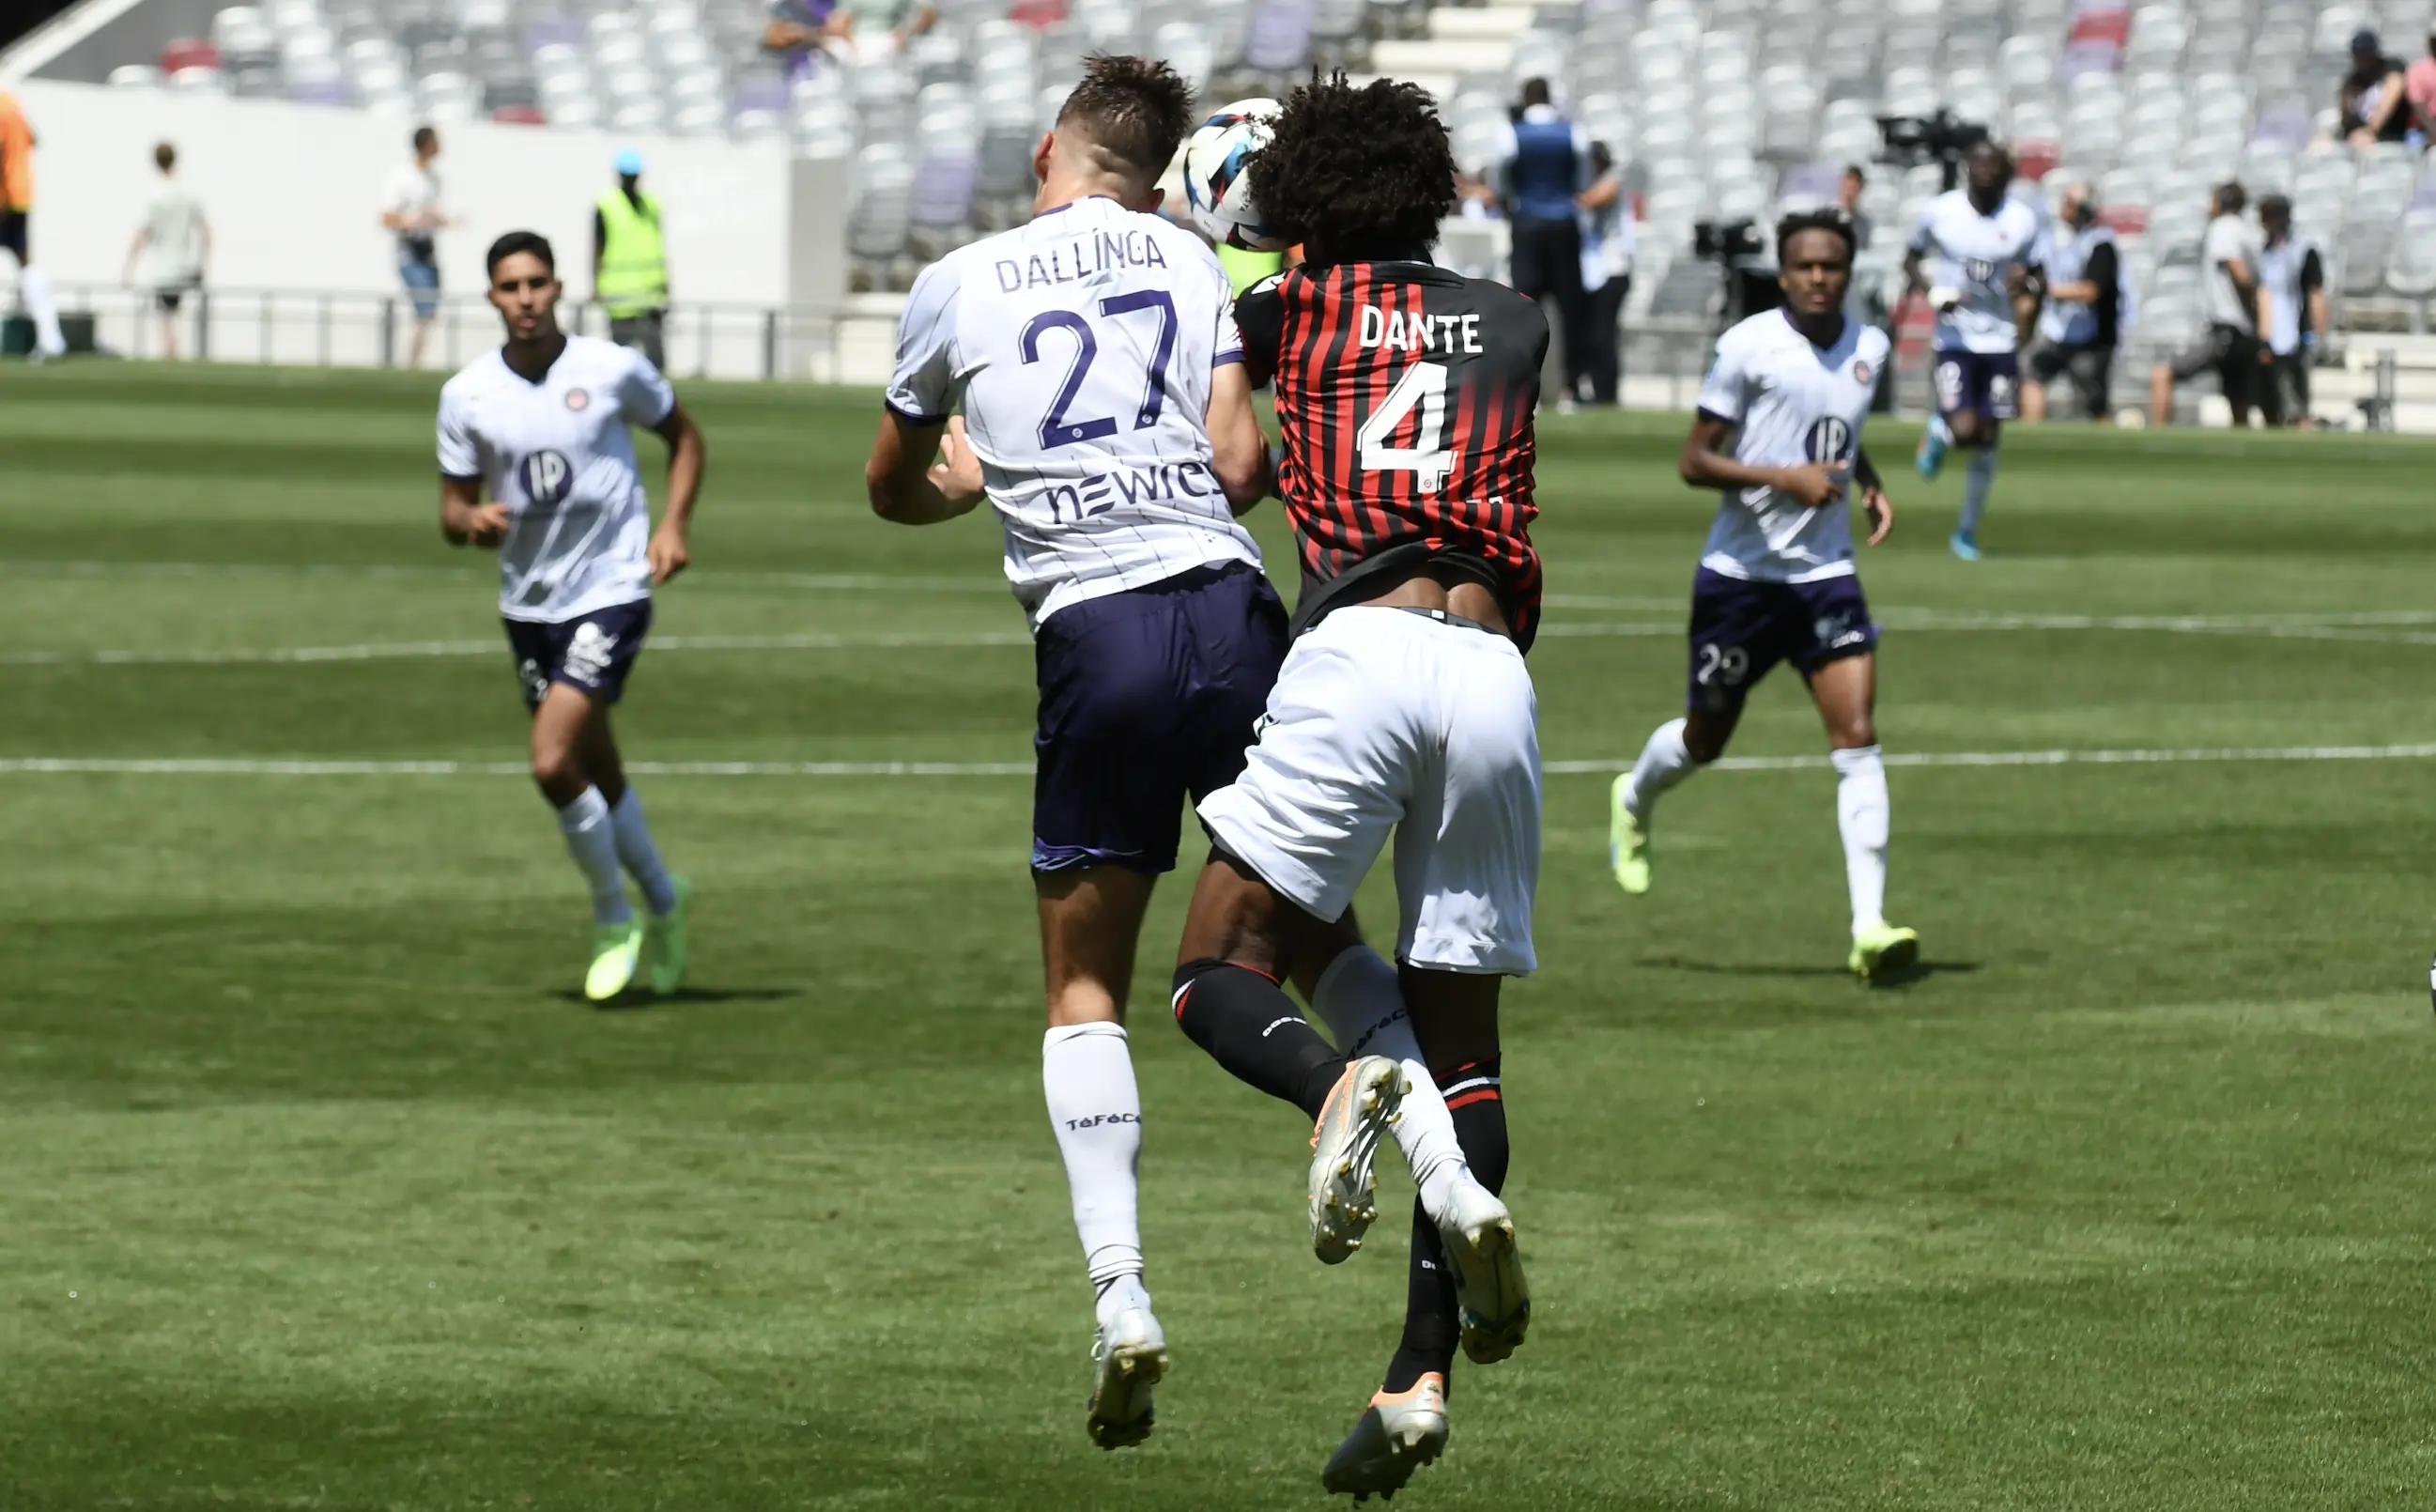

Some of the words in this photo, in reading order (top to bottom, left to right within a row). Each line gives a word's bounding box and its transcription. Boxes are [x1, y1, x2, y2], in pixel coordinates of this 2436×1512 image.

[1018, 289, 1179, 451] 27
[1360, 303, 1484, 354] DANTE
[1356, 361, 1458, 494] 4
